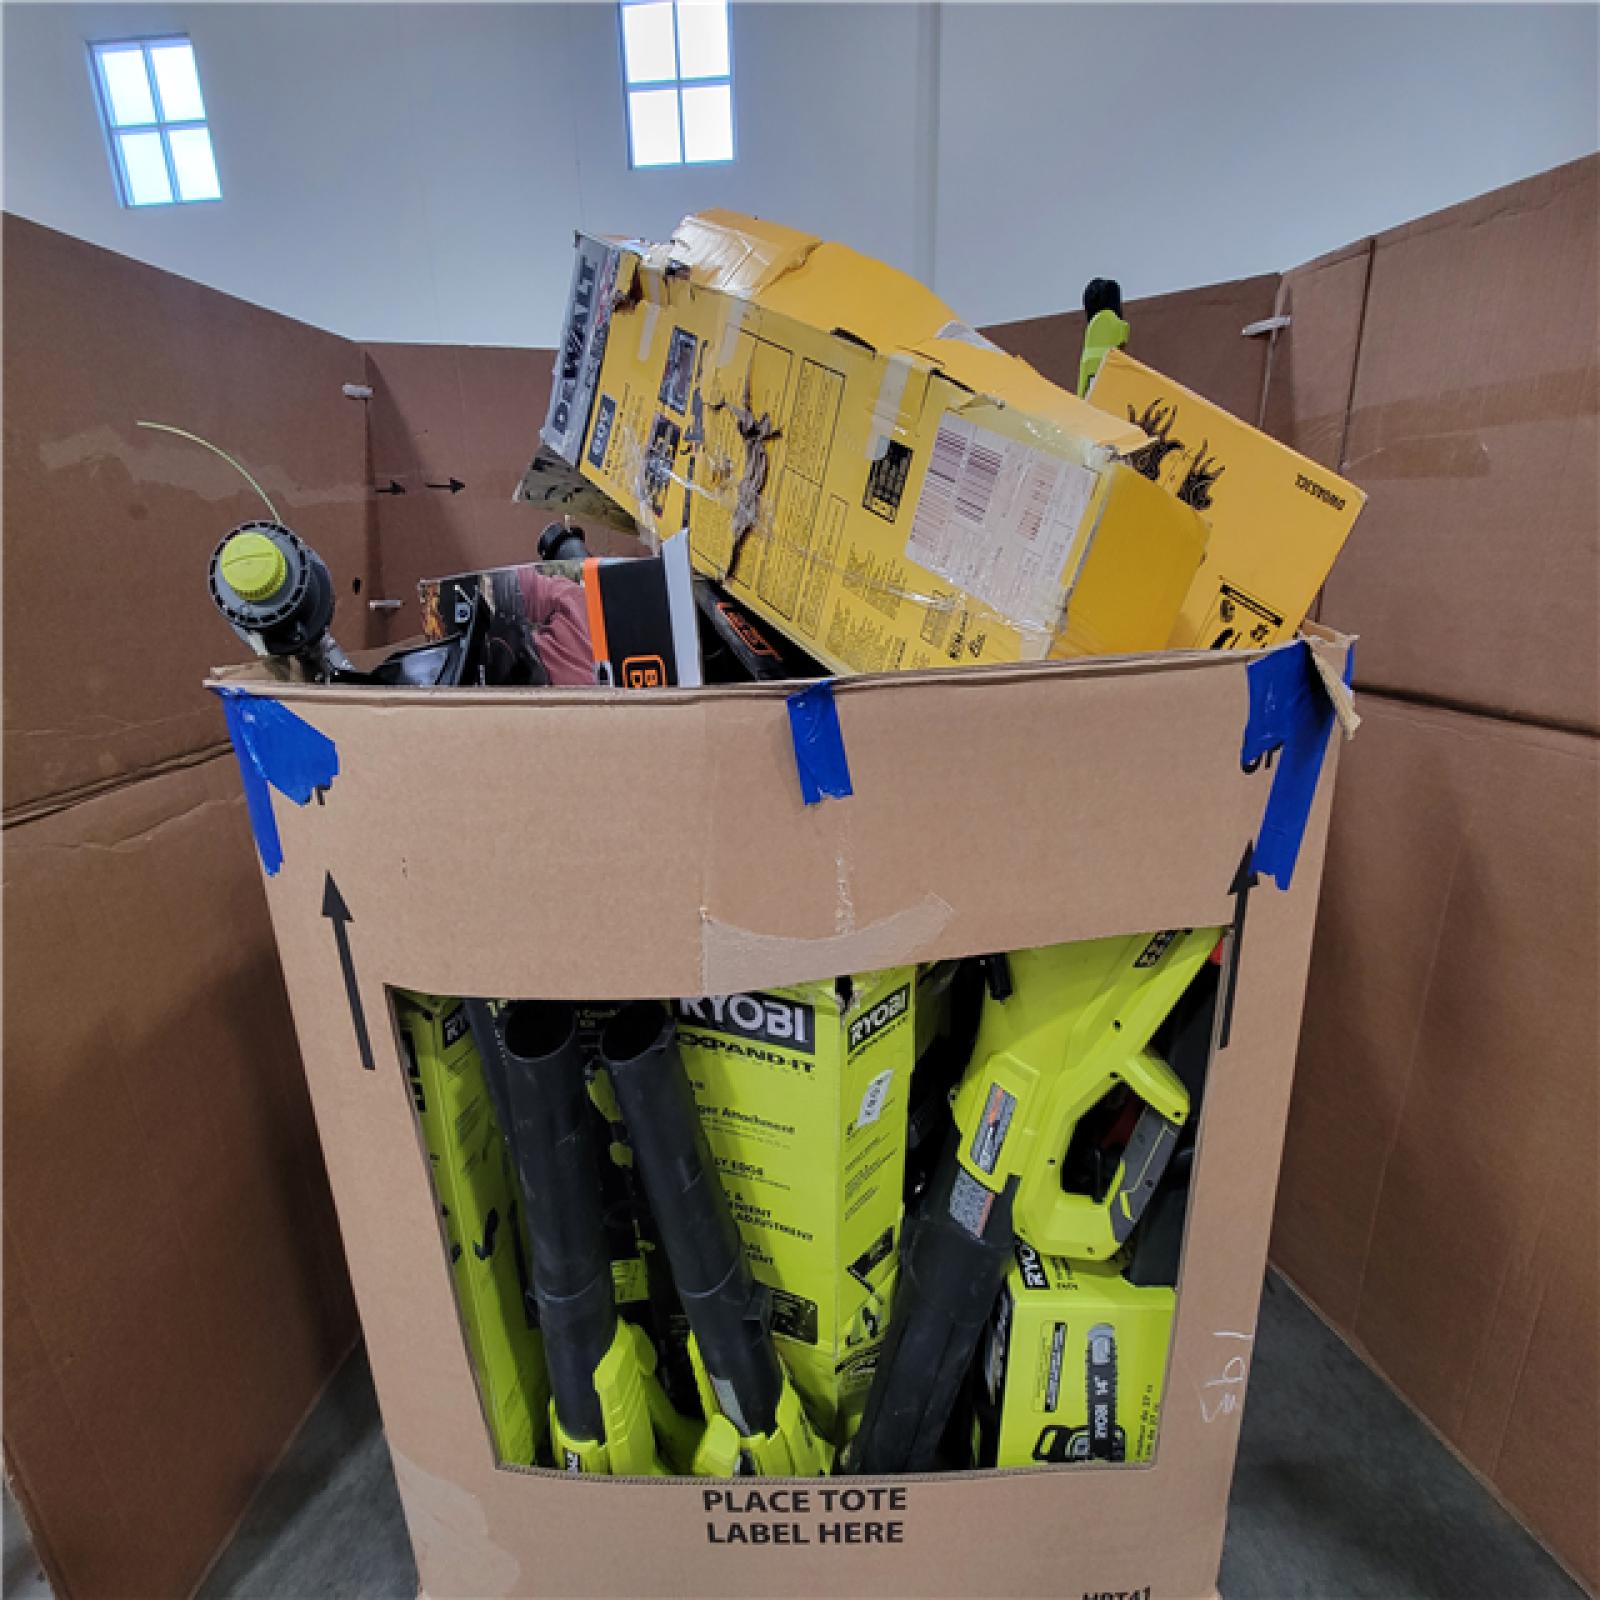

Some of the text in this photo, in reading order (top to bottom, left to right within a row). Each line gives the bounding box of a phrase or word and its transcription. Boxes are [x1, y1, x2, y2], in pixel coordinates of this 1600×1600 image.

[852, 989, 906, 1046] RYOBI
[1019, 1244, 1046, 1286] RYO
[703, 1487, 907, 1513] PLACE TOTE
[707, 1521, 904, 1544] LABEL HERE
